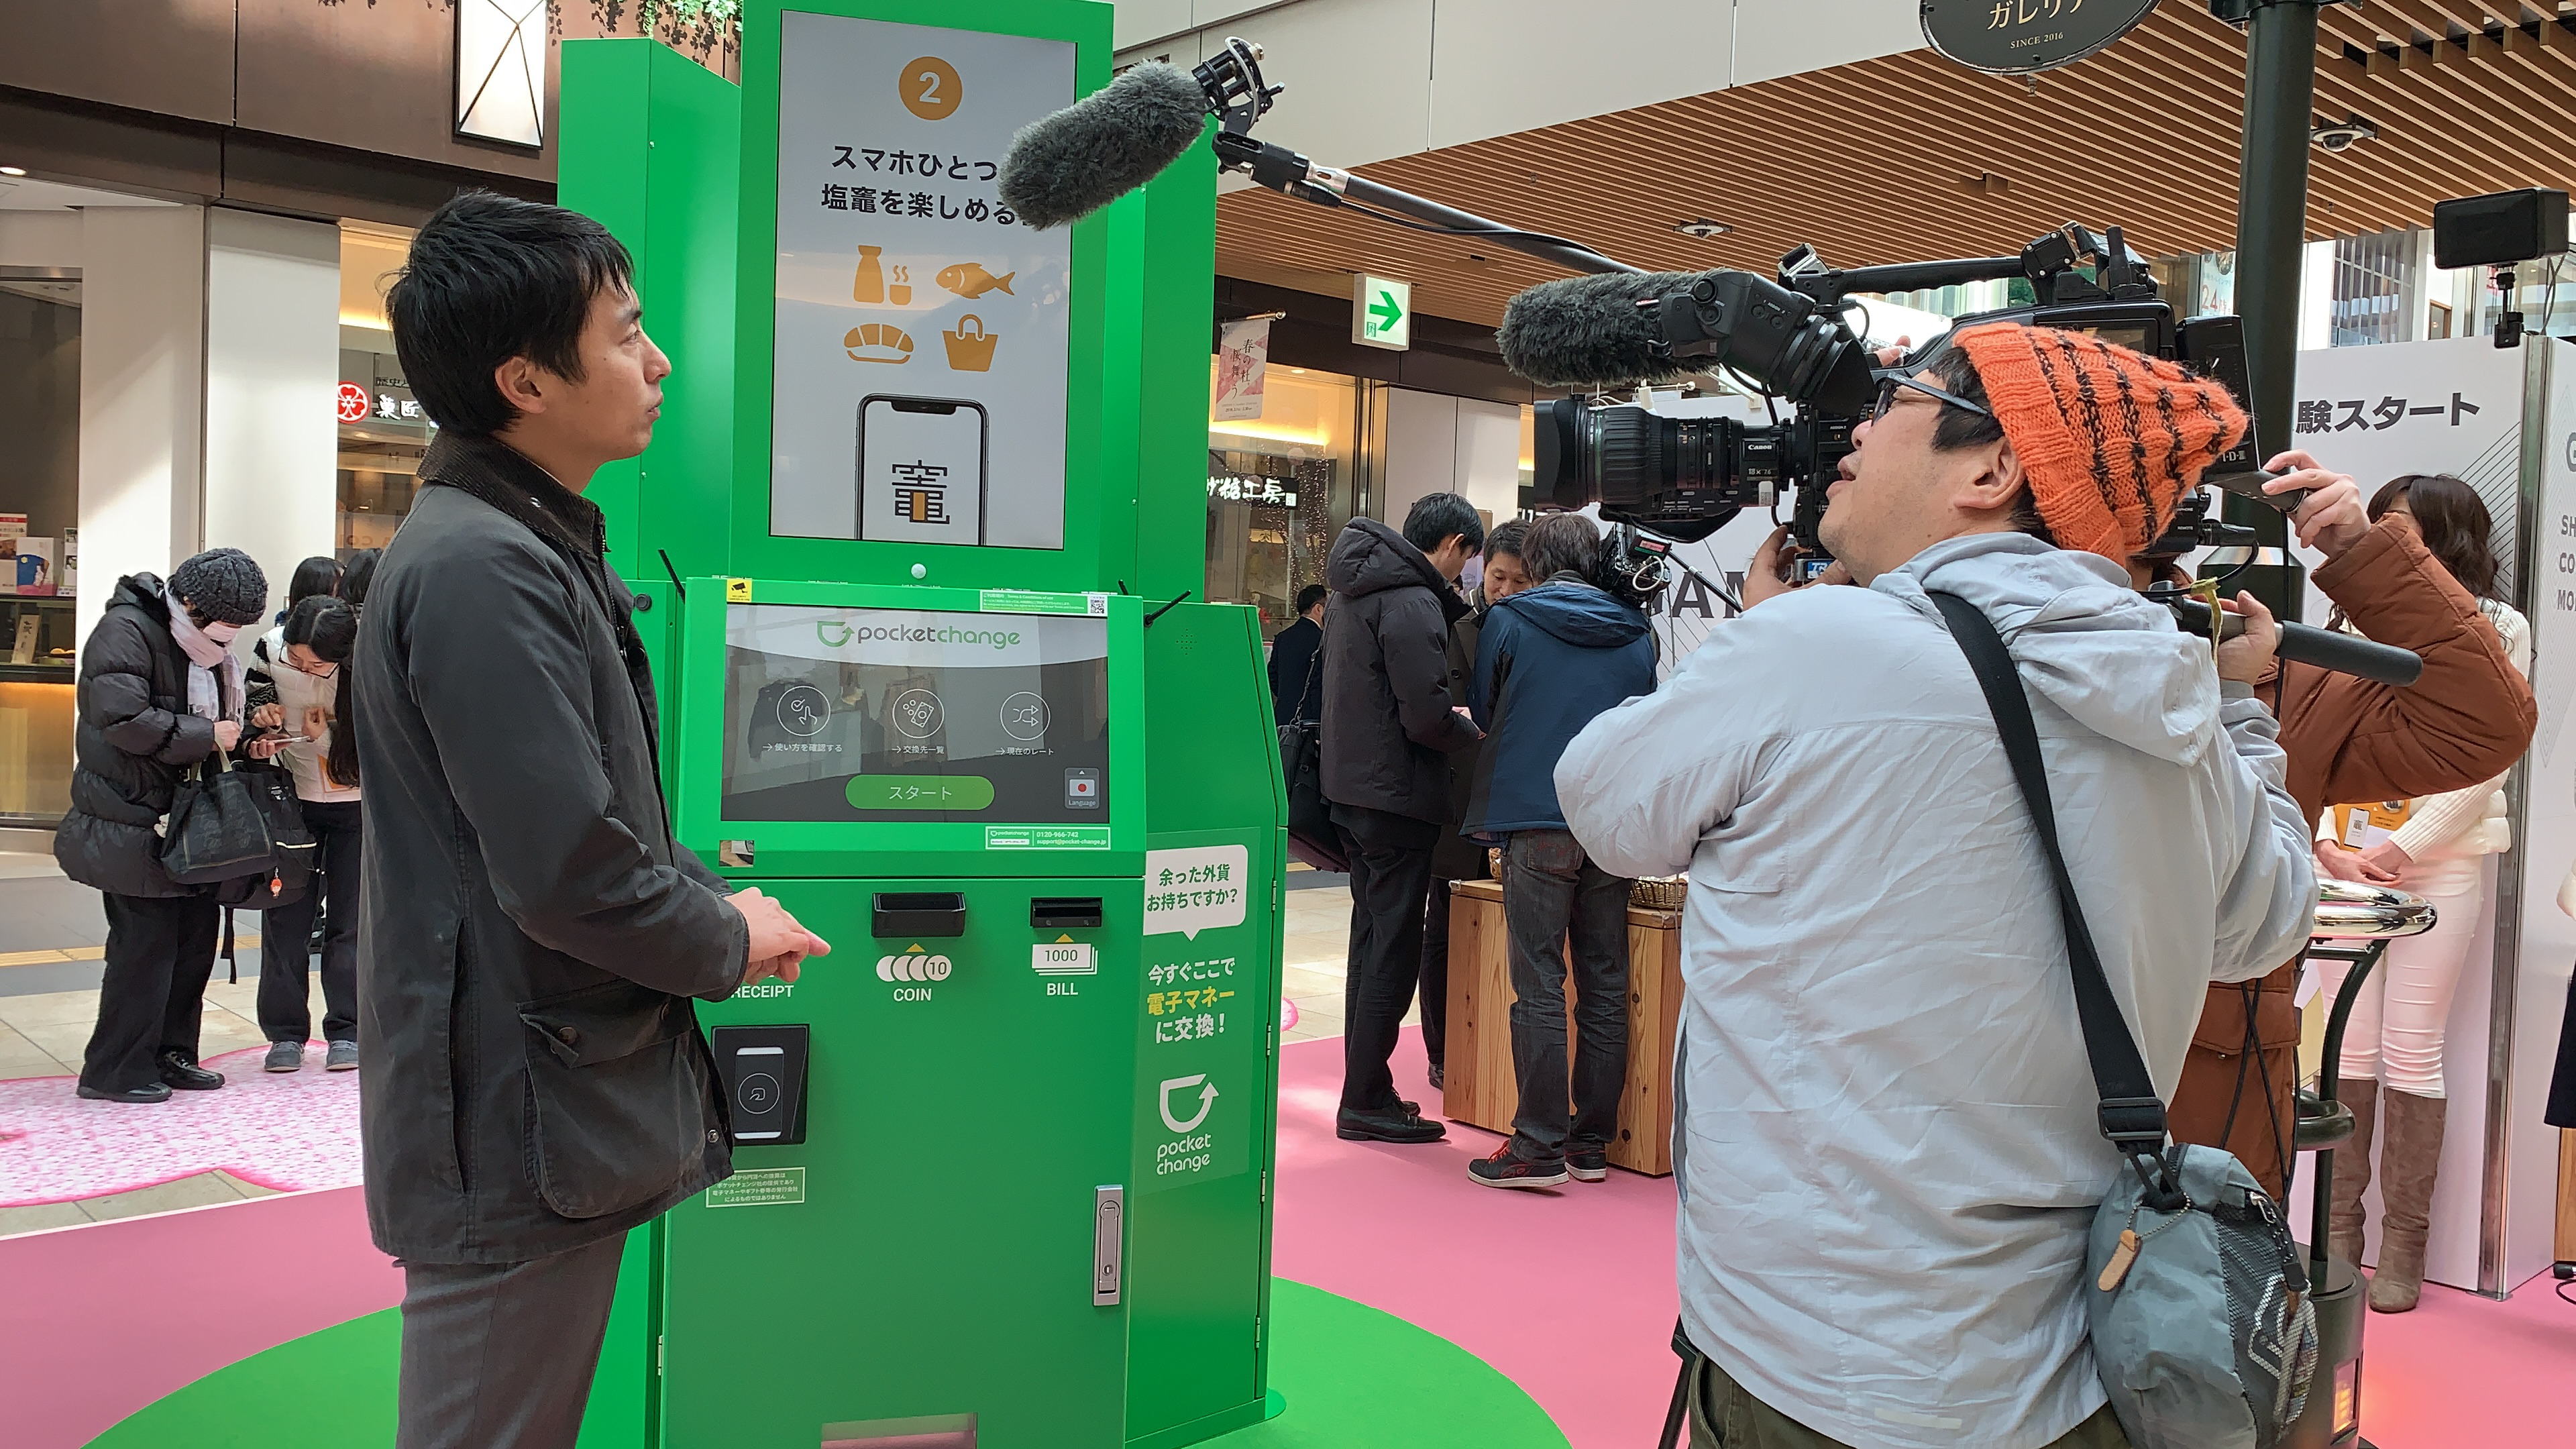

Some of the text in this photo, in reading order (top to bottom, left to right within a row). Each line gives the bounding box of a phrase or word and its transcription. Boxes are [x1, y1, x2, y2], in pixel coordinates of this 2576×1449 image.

[2010, 32, 2064, 49] SINCE 2016
[919, 71, 941, 104] 2
[832, 145, 998, 182] スマホひとつ
[821, 183, 1028, 227] 塩竈を楽しめる
[2295, 392, 2481, 434] 験スタート
[2557, 589, 2576, 611] MO
[858, 624, 1021, 650] pocketchange
[774, 743, 843, 752] 使い方を確認する
[903, 745, 945, 754] 交換先一覧
[1006, 747, 1055, 756] 現在のレート
[889, 786, 952, 801] スタート
[1159, 863, 1230, 887] 余った外貨
[1045, 949, 1078, 962] 1000
[929, 961, 947, 975] 10
[1148, 957, 1236, 986] 今すぐここで
[893, 987, 932, 1002] COIN
[1046, 982, 1079, 996] BILL
[1146, 985, 1235, 1016] 電子マネー
[1157, 1133, 1212, 1162] pocket
[1156, 1153, 1210, 1175] change
